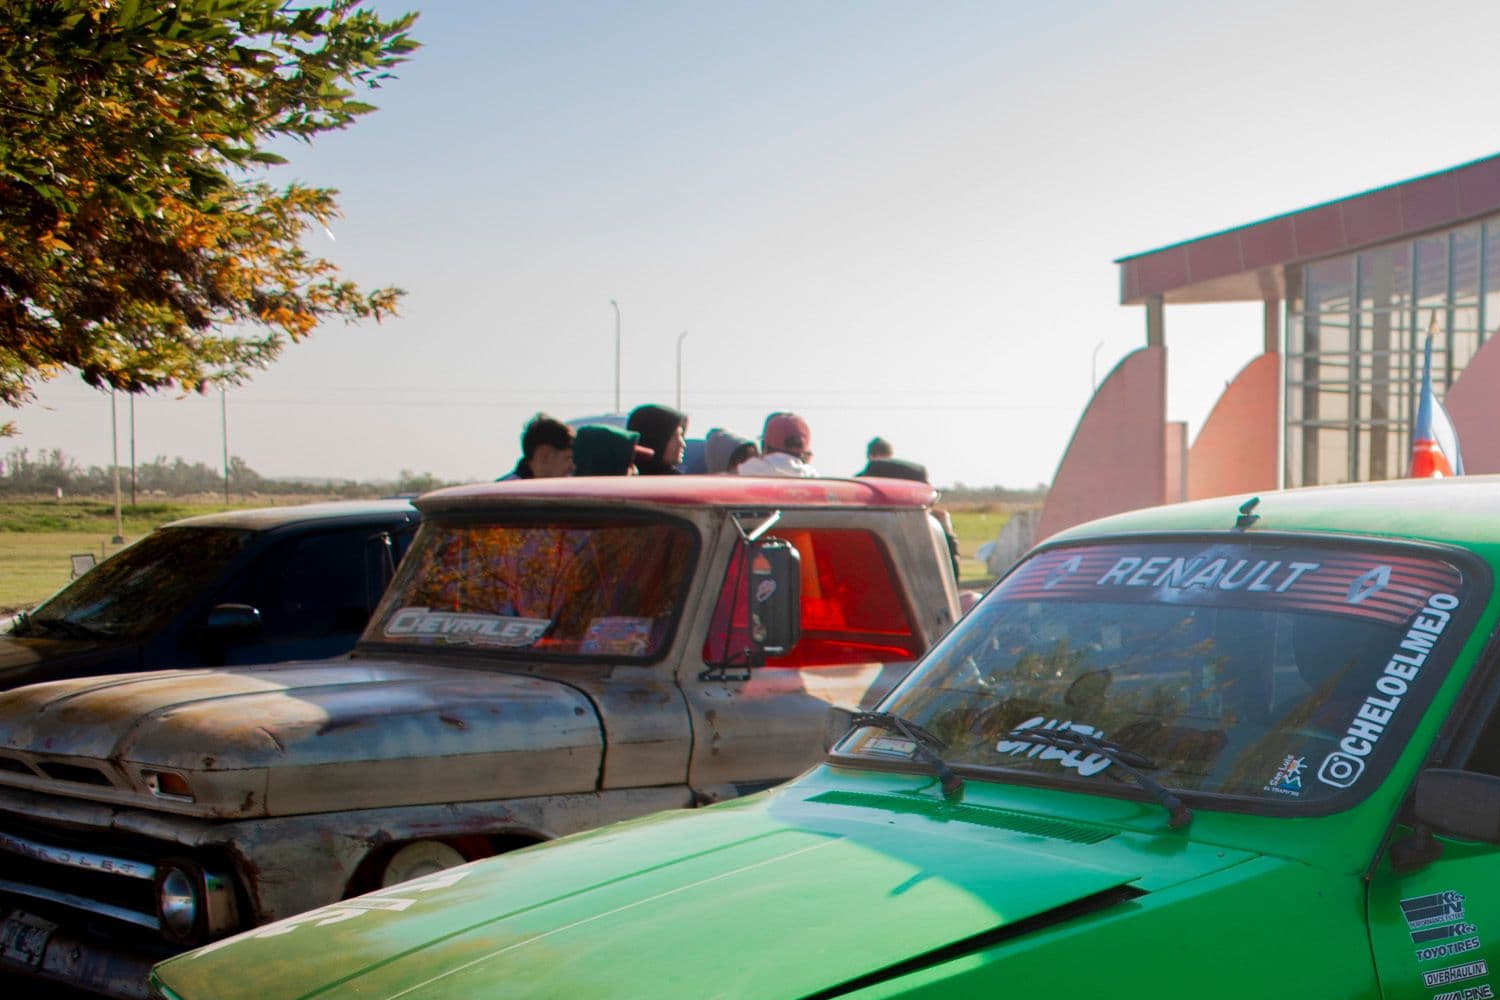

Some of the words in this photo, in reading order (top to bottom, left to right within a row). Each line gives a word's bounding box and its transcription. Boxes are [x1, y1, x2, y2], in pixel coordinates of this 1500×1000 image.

[1097, 556, 1320, 593] RENAULT
[386, 607, 549, 640] CHEVROLET
[1339, 592, 1460, 757] CHELOELMEJO
